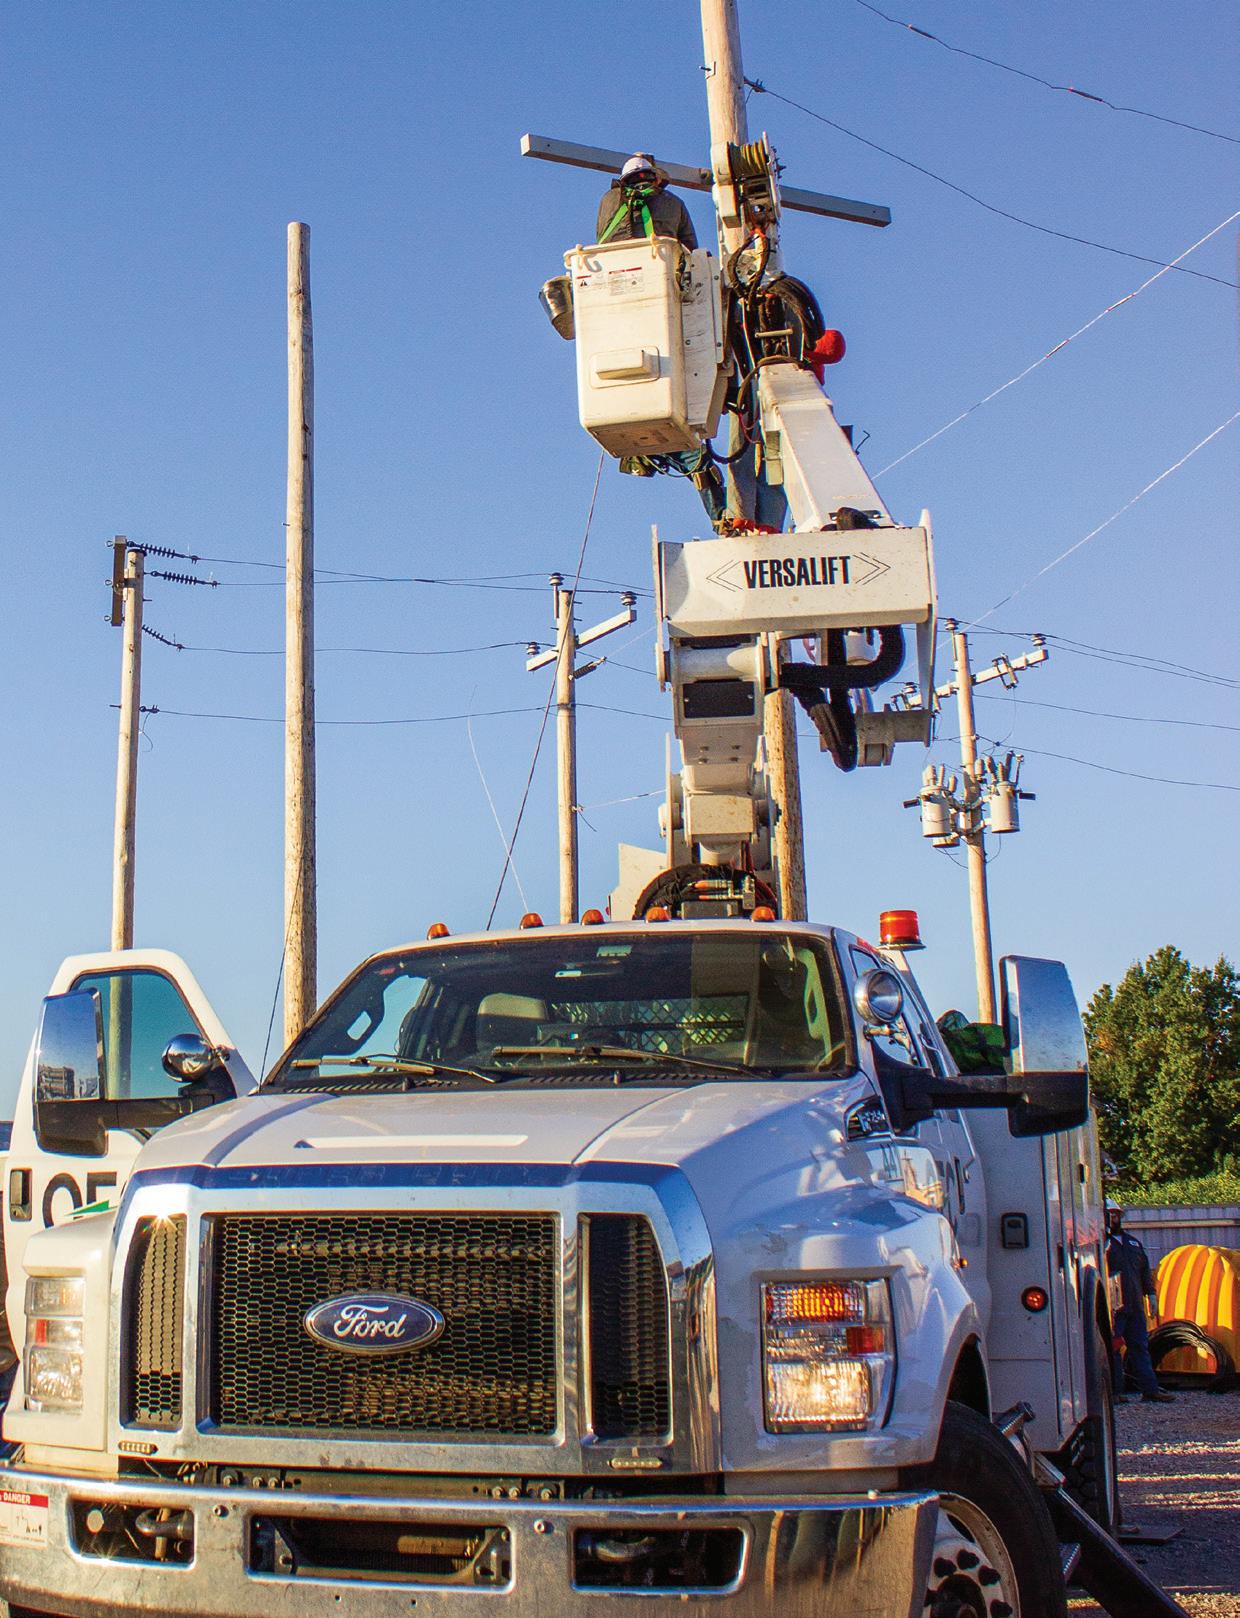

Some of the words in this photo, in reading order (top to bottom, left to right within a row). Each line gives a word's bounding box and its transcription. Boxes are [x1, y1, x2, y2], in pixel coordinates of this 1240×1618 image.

[743, 555, 850, 589] VERSALIFT
[334, 1304, 407, 1338] Ford
[3, 1492, 31, 1505] DANGER
